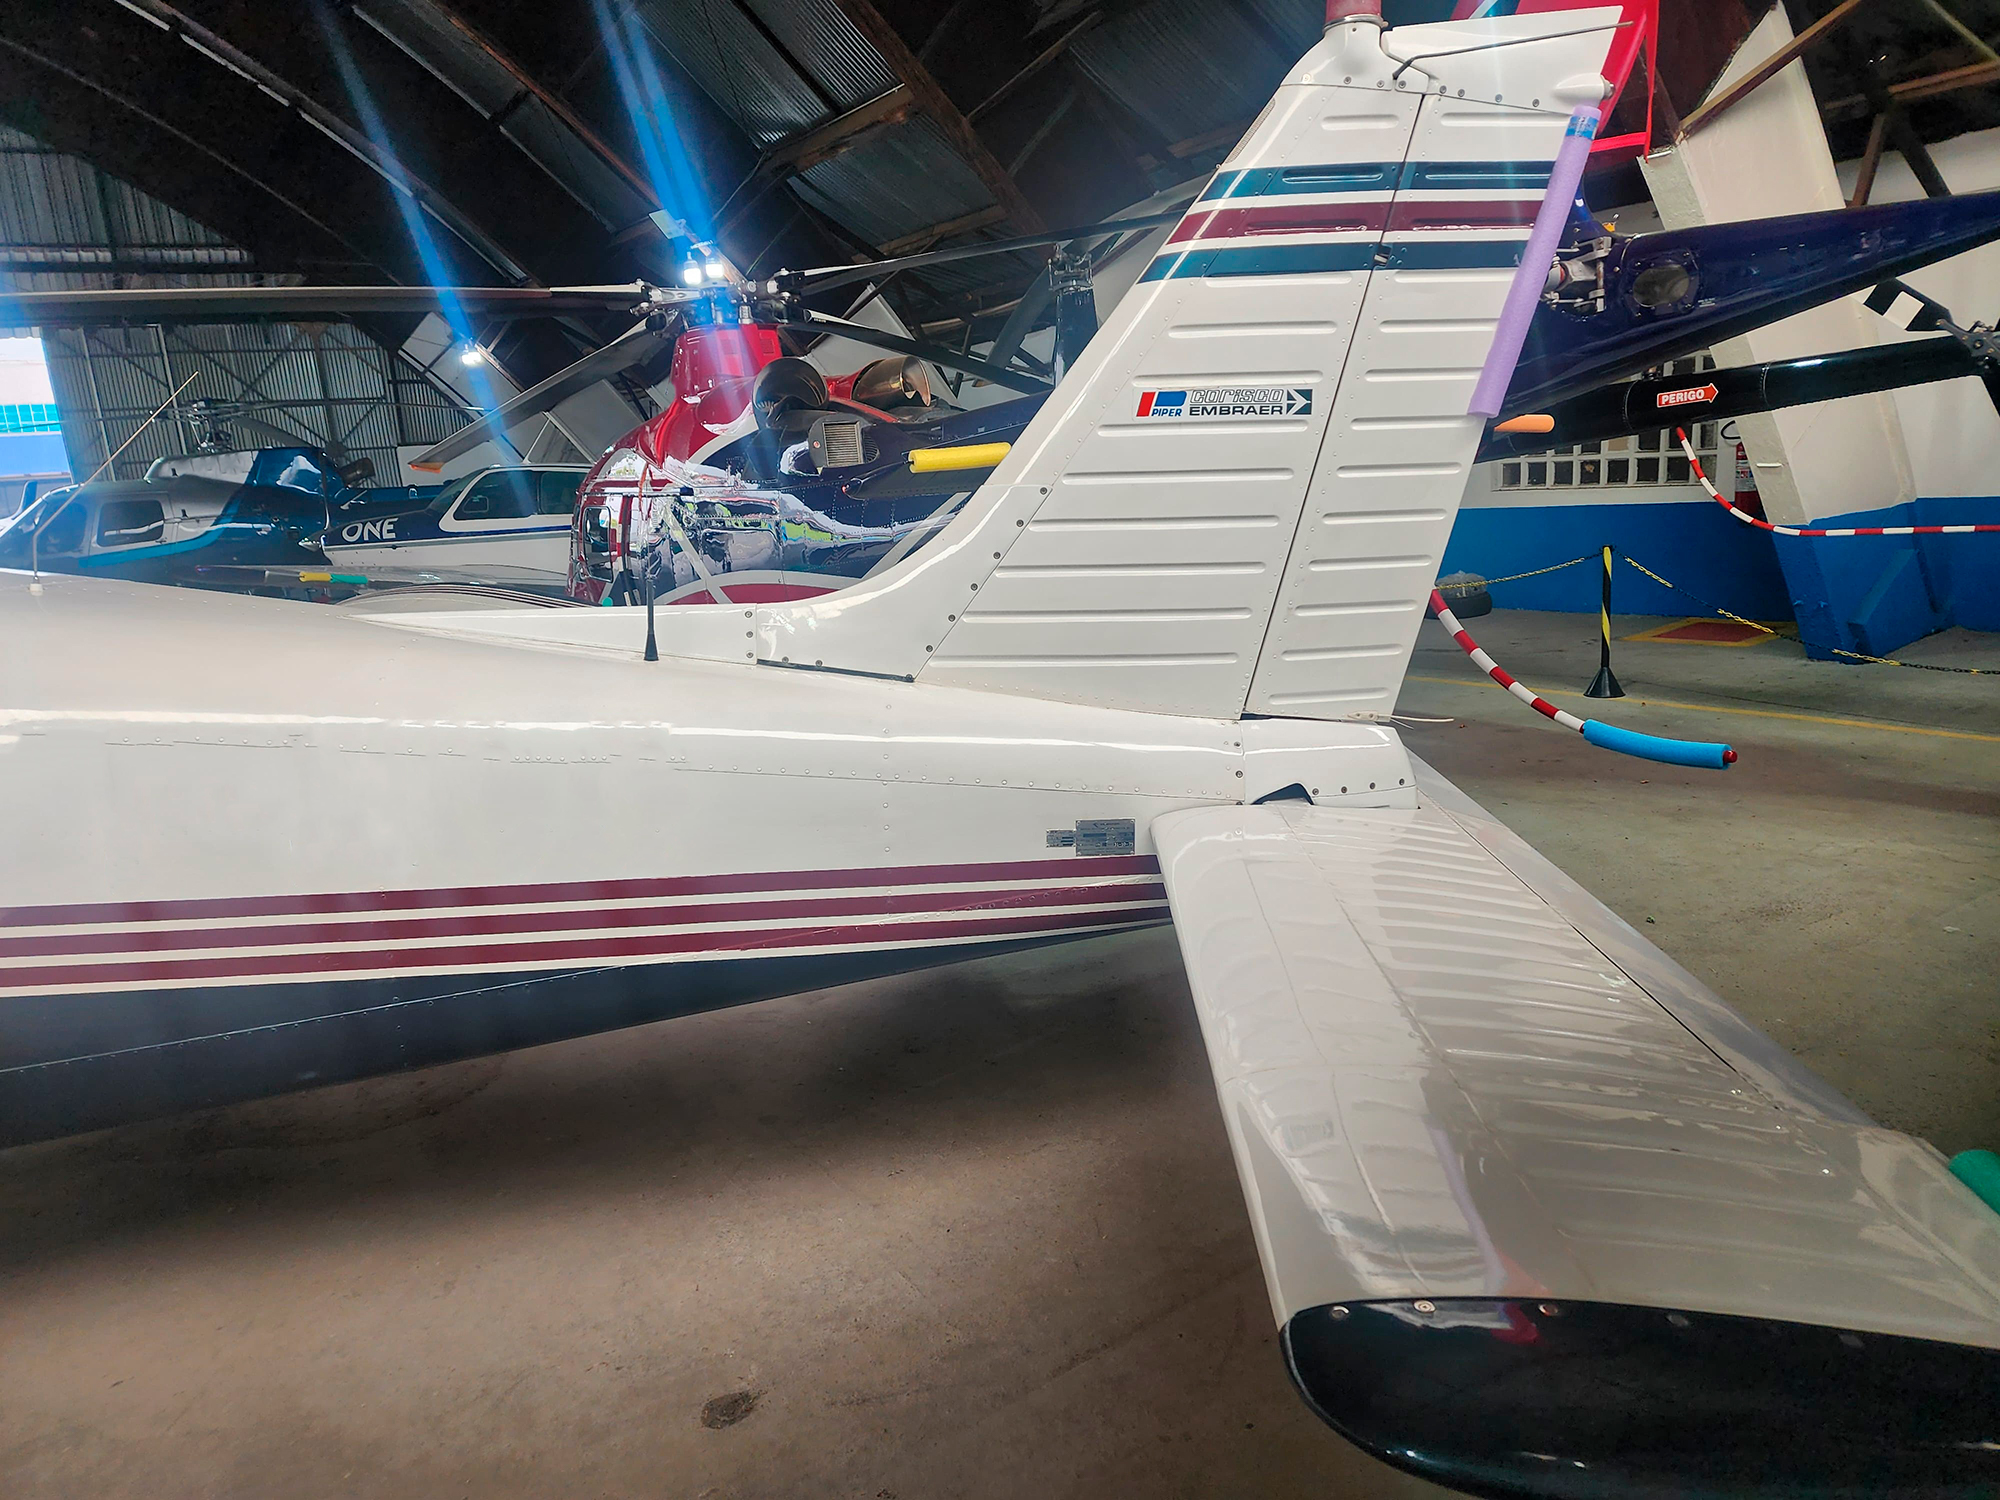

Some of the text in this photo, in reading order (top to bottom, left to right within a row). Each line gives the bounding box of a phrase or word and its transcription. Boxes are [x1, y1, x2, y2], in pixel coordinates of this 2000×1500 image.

[1661, 389, 1705, 405] PERIGO
[1151, 408, 1182, 417] PIPER
[1189, 405, 1283, 416] EMBRAER
[341, 517, 399, 542] ONE
